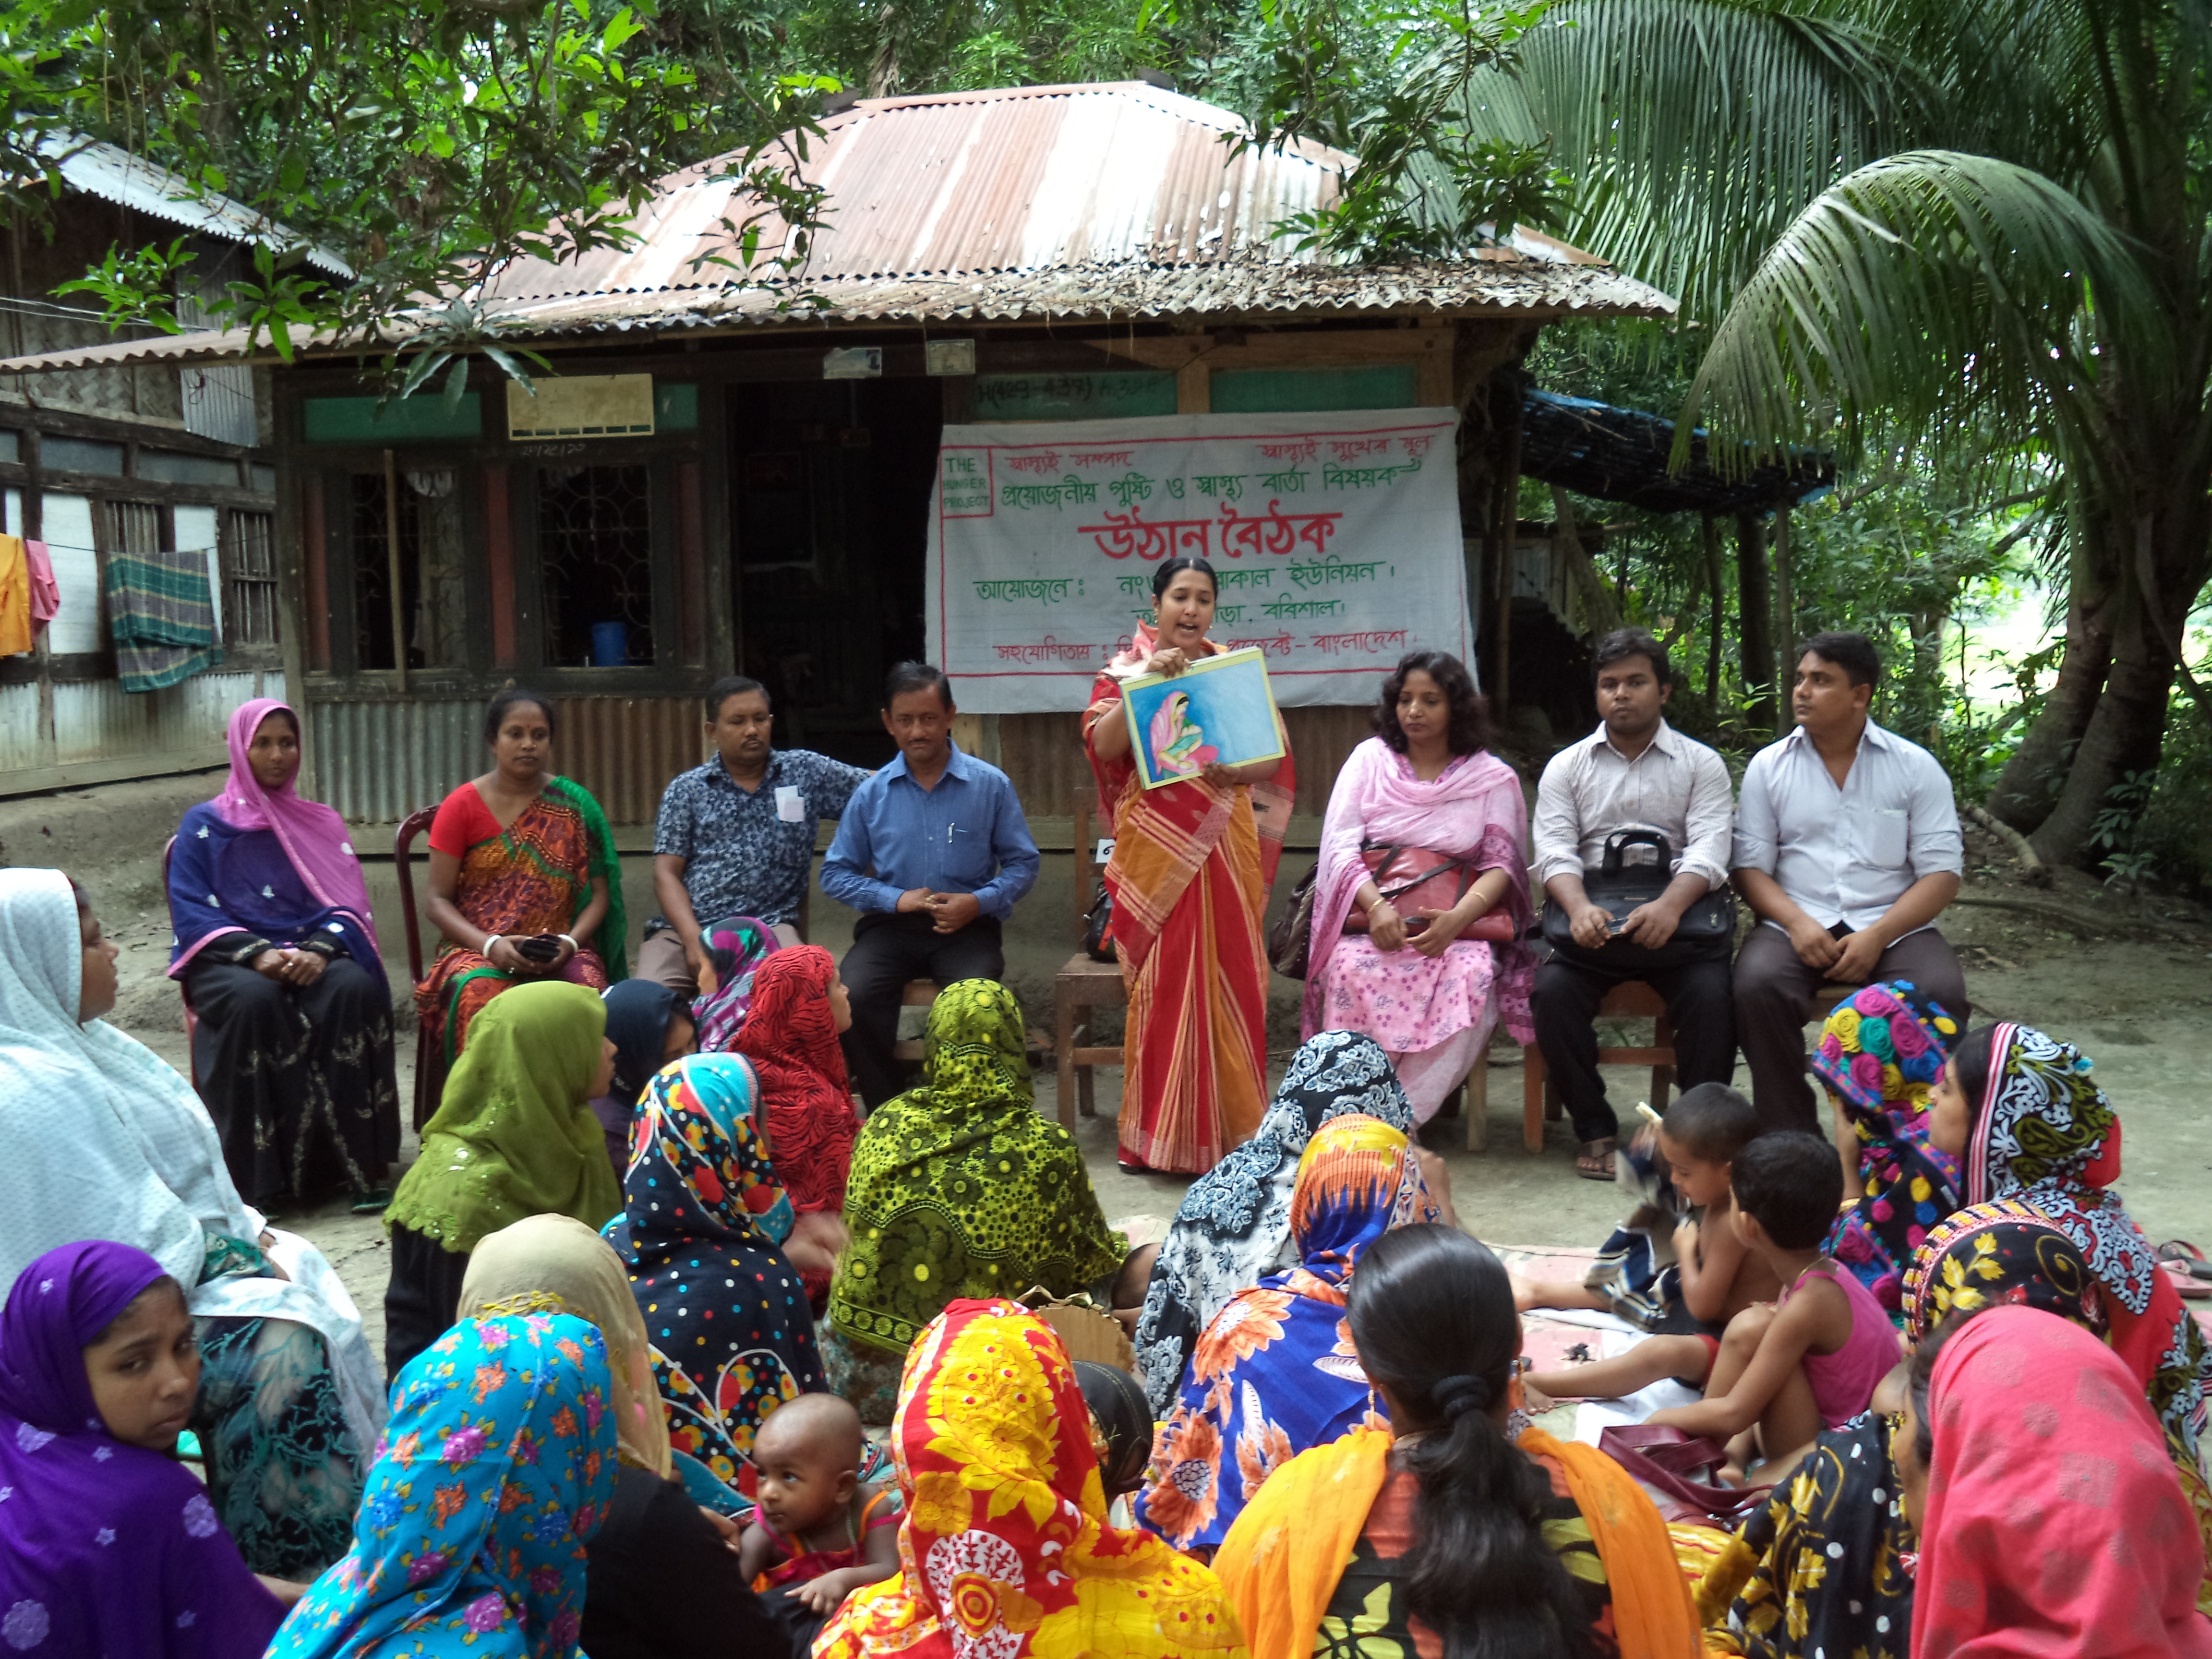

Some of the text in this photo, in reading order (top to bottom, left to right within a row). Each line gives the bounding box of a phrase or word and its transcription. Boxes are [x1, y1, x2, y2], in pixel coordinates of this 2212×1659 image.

[945, 457, 976, 473] THE
[943, 479, 986, 490] HUNGER
[1001, 458, 1422, 511] প্রয়োজনীয় পুষ্টি ও স্বাস্থ্য বার্তা বিষয়ক
[944, 496, 989, 508] PROJECT
[1077, 498, 1343, 561] উঠান বৈঠক
